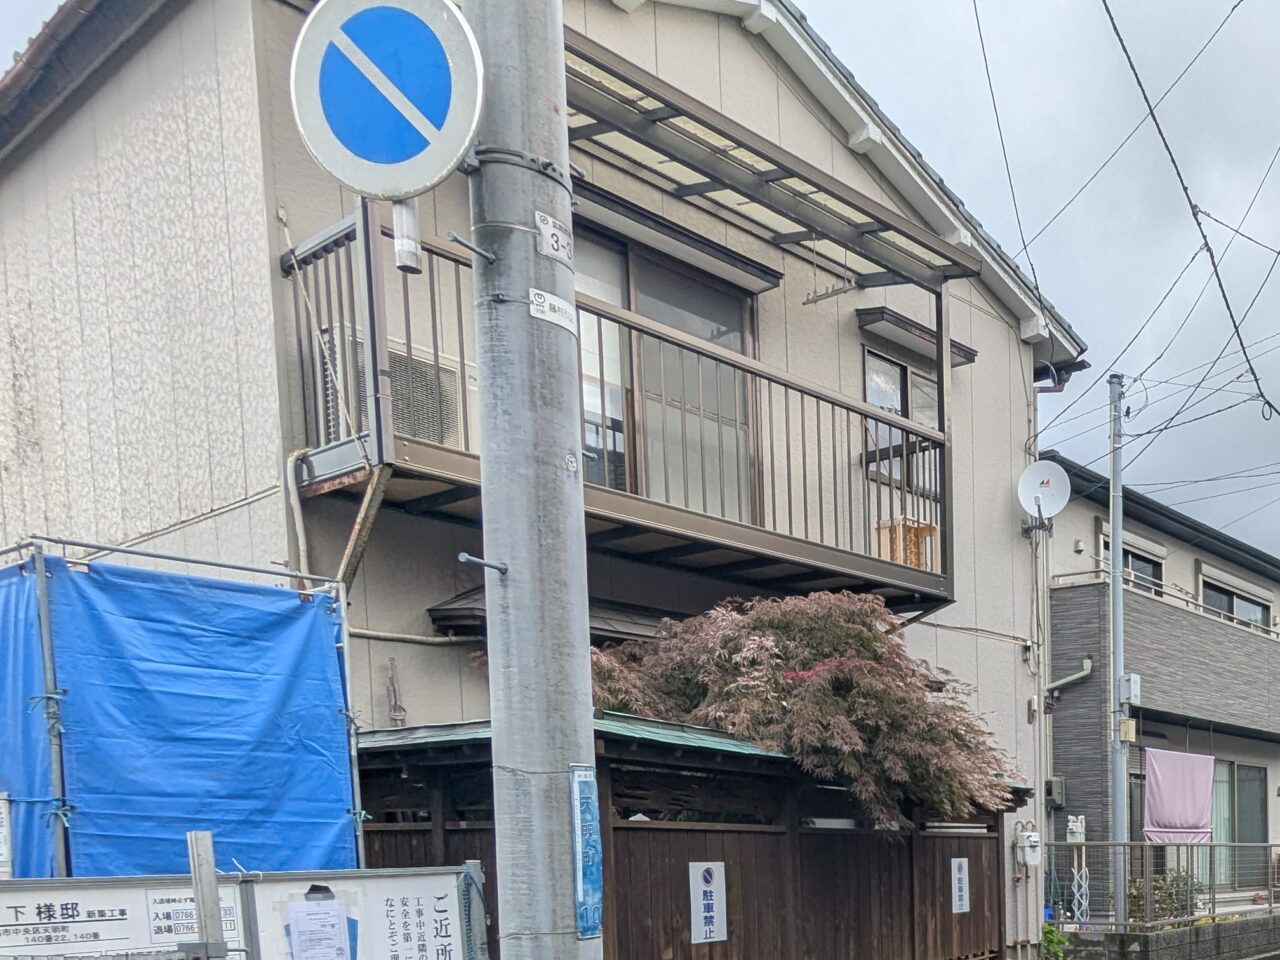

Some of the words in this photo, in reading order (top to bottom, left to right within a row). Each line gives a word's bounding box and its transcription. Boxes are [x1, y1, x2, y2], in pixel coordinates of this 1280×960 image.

[957, 876, 965, 911] 駐車禁止
[152, 911, 172, 921] 入場
[702, 889, 716, 940] 駐車禁止
[153, 924, 174, 935] 退場
